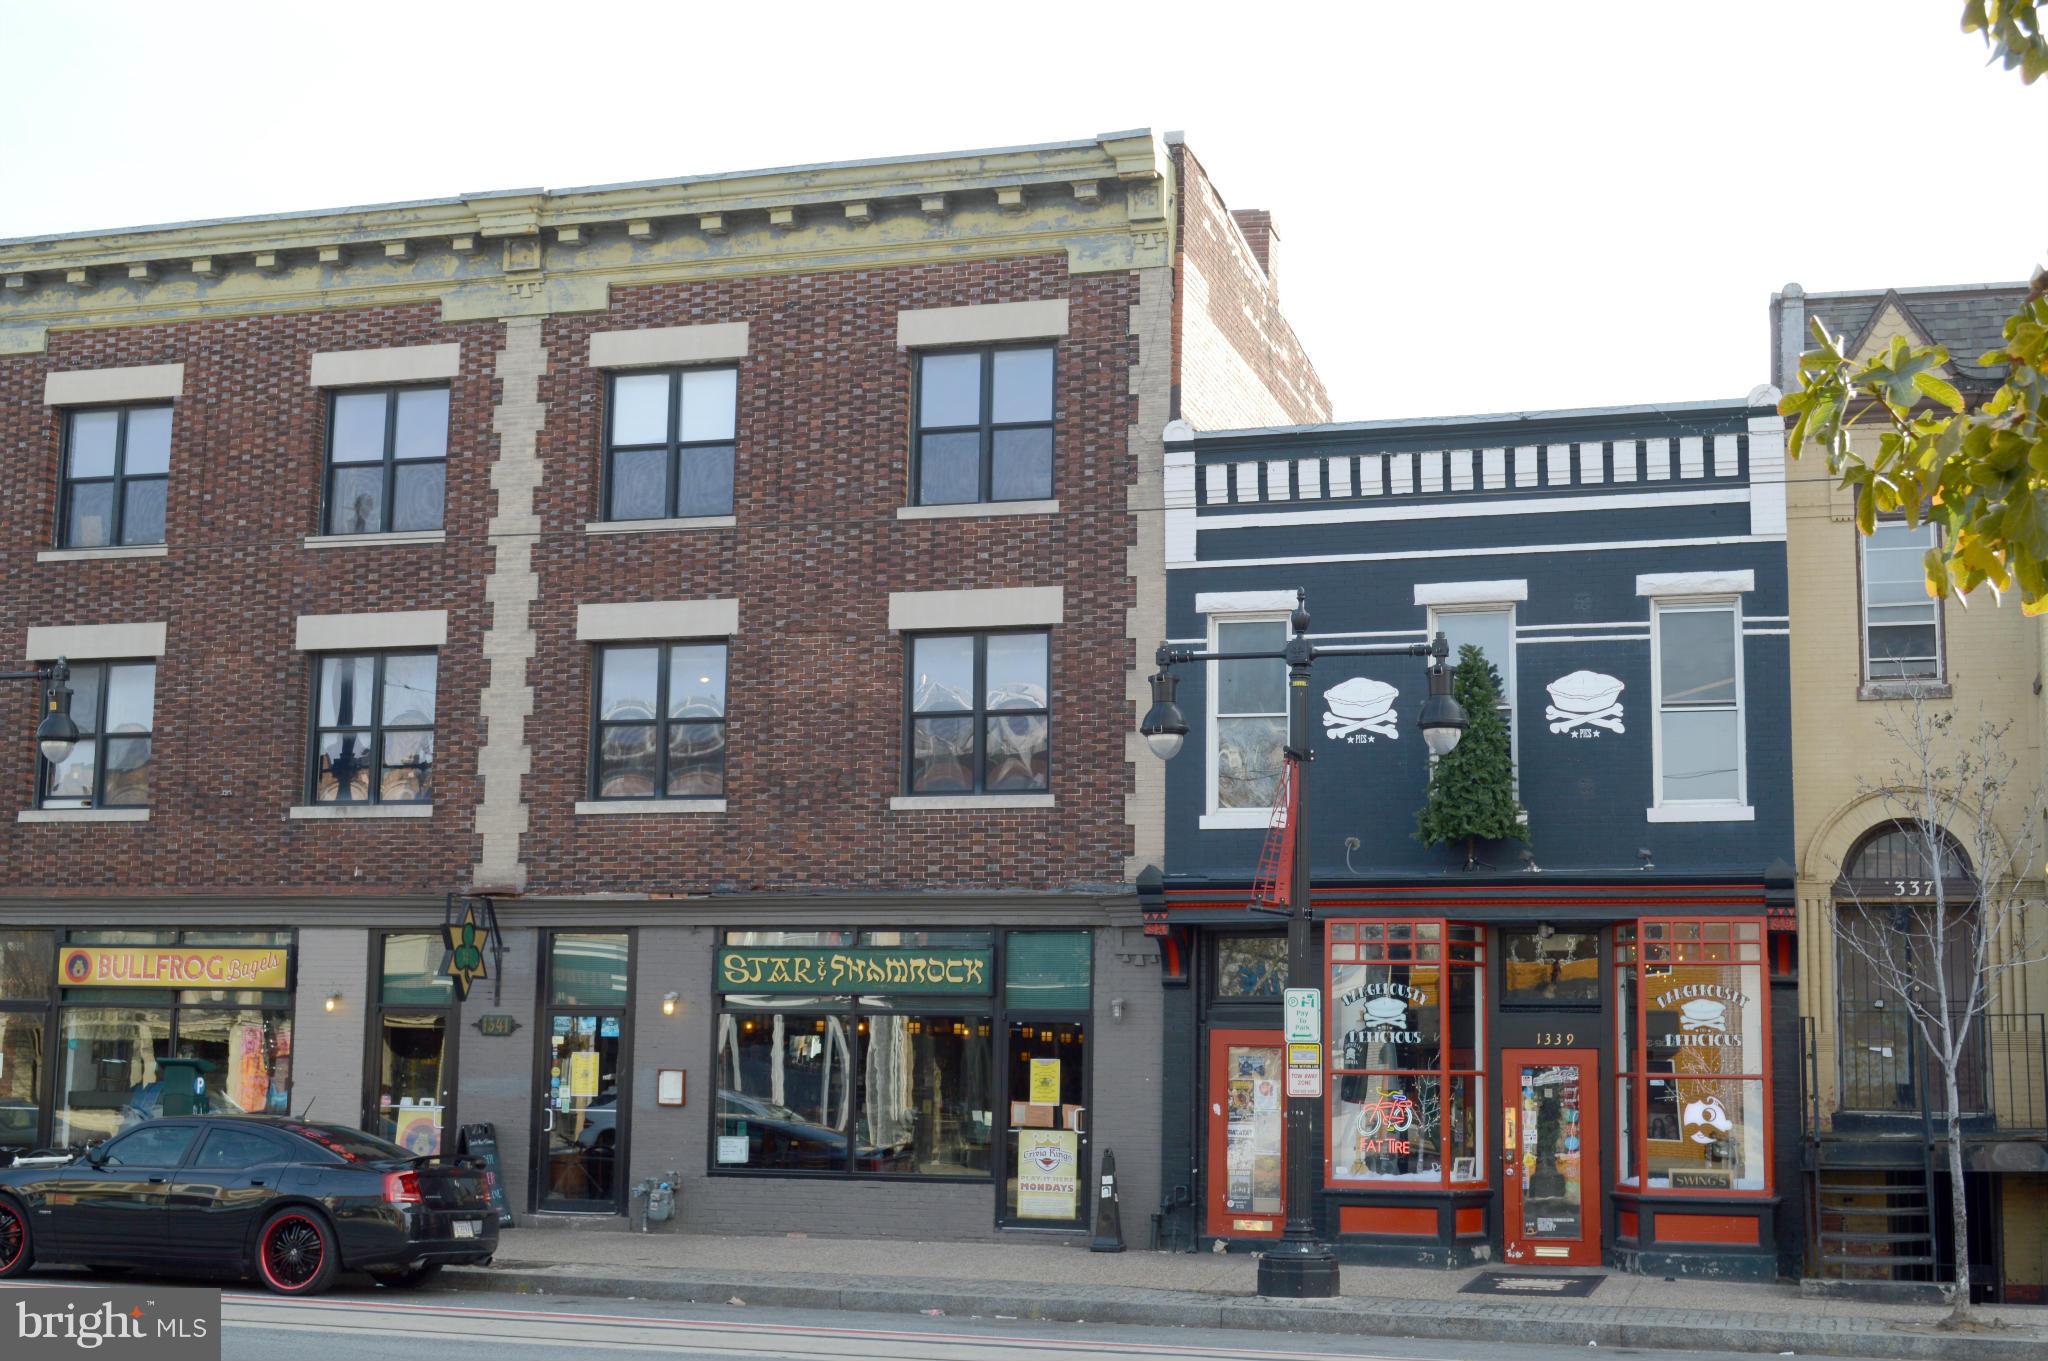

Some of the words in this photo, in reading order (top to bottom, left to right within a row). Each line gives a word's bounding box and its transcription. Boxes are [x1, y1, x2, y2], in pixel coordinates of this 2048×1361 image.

[1355, 734, 1367, 744] PIES
[1884, 881, 1934, 896] 337
[96, 954, 224, 982] BULLFROG
[226, 952, 280, 981] Bagels
[724, 954, 816, 984] STAR
[831, 954, 984, 986] SHAMROCK
[1349, 1031, 1422, 1044] DELICIOUS
[1537, 1033, 1574, 1046] 1339
[1665, 1033, 1742, 1046] DELICIOUS
[1359, 1136, 1383, 1153] FAT
[1385, 1138, 1411, 1154] TIRE
[1049, 1148, 1073, 1161] Kings
[1020, 1183, 1074, 1193] MONDAYS
